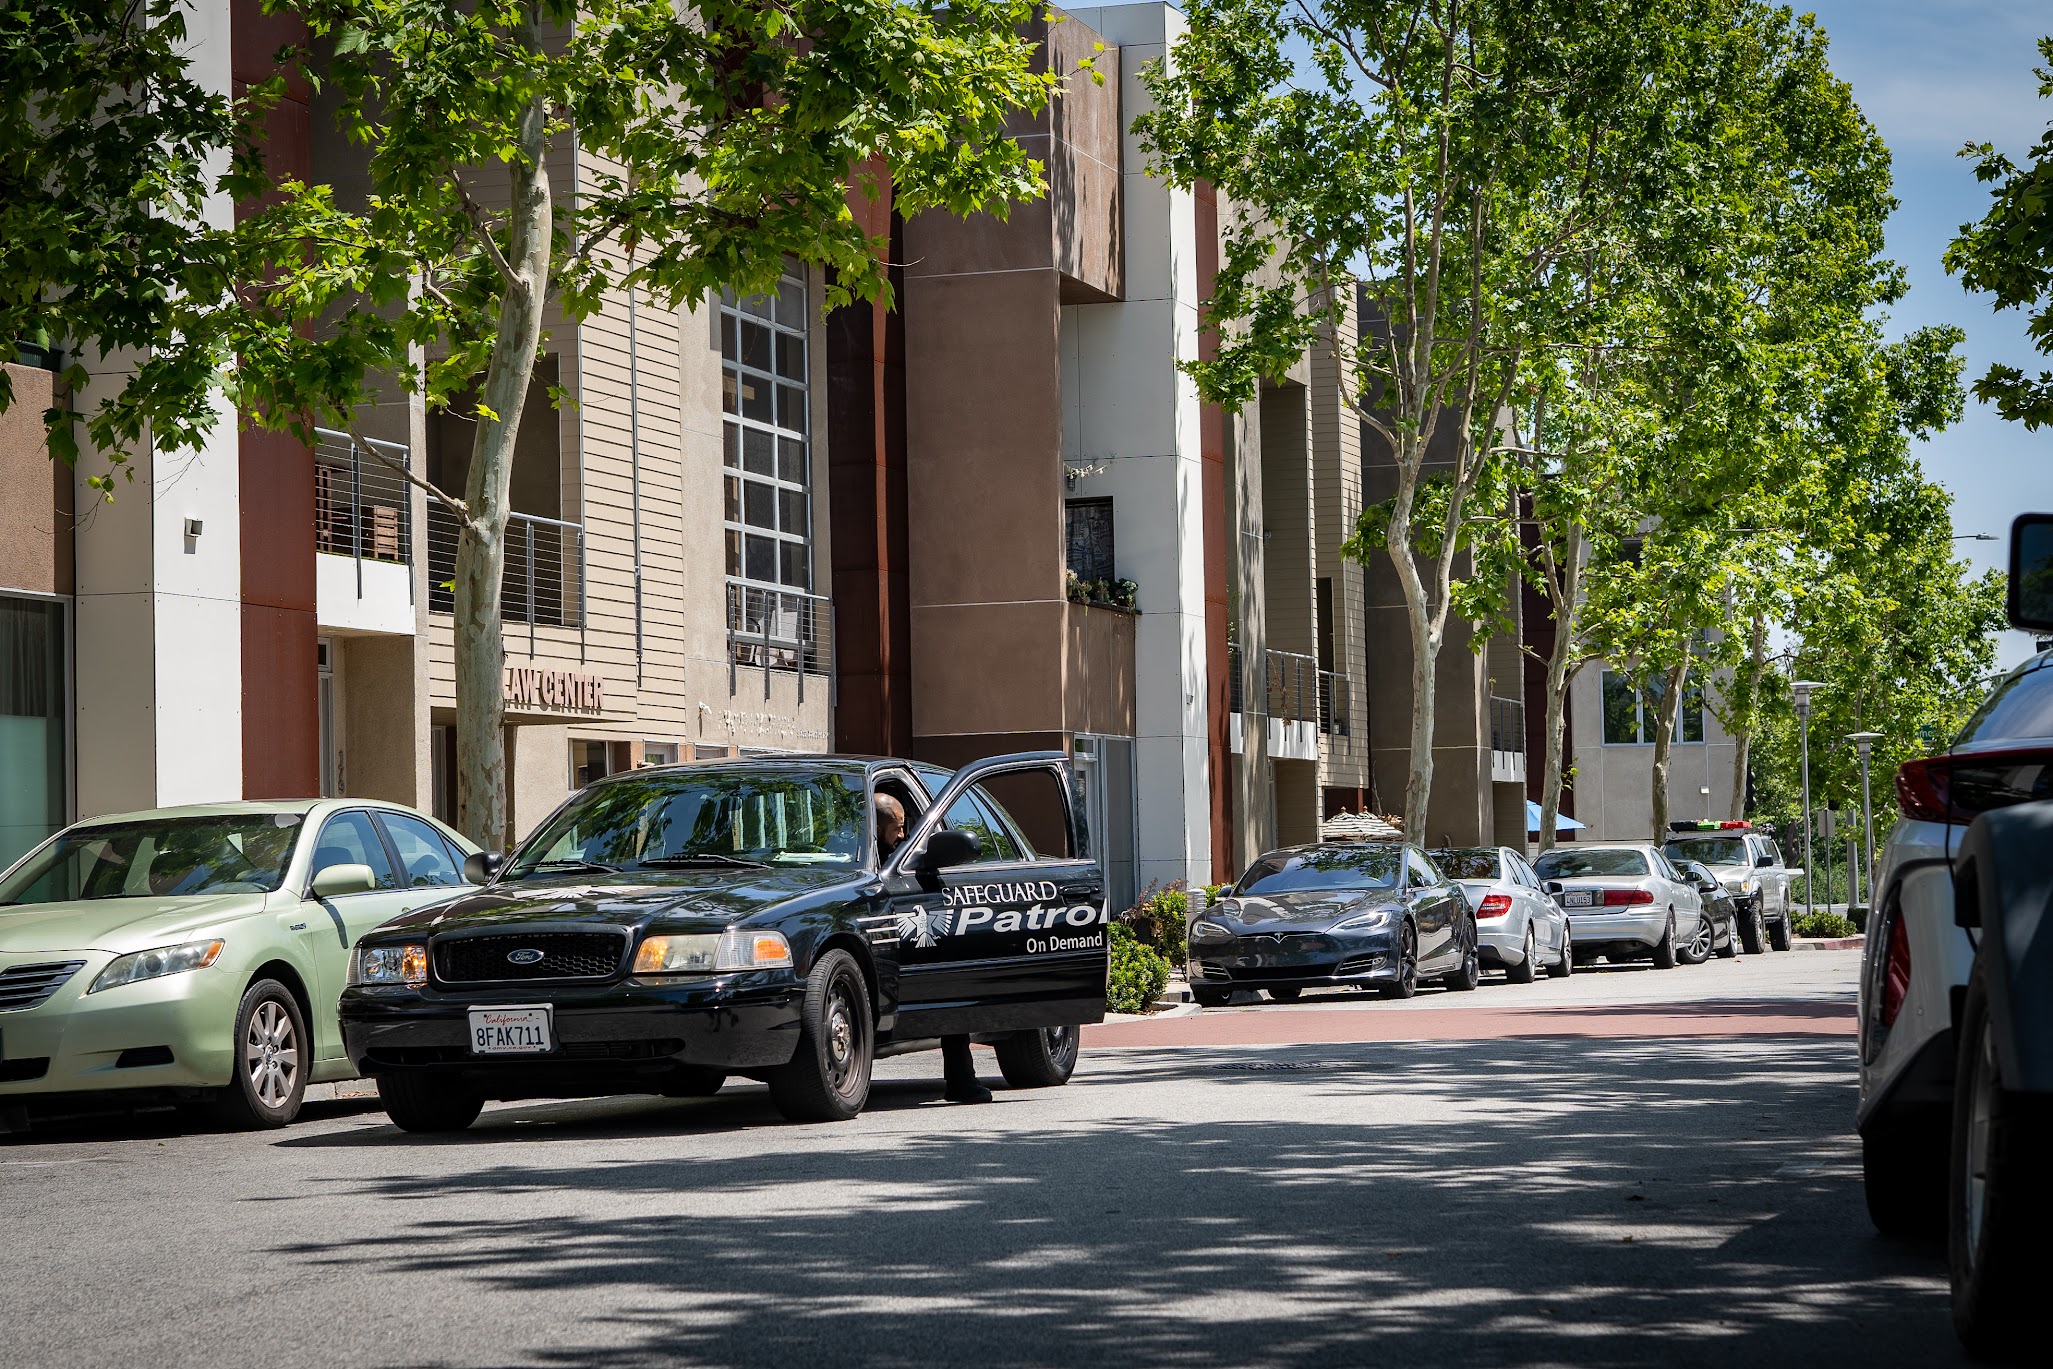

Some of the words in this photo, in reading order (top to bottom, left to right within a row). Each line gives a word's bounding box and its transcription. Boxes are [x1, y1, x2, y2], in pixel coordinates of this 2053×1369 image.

[541, 668, 604, 708] CENTER
[941, 881, 1057, 906] SAFEGUARD
[1027, 937, 1047, 953] On
[1050, 931, 1103, 951] Demand
[486, 1014, 532, 1026] California
[476, 1026, 544, 1046] 8FAK711
